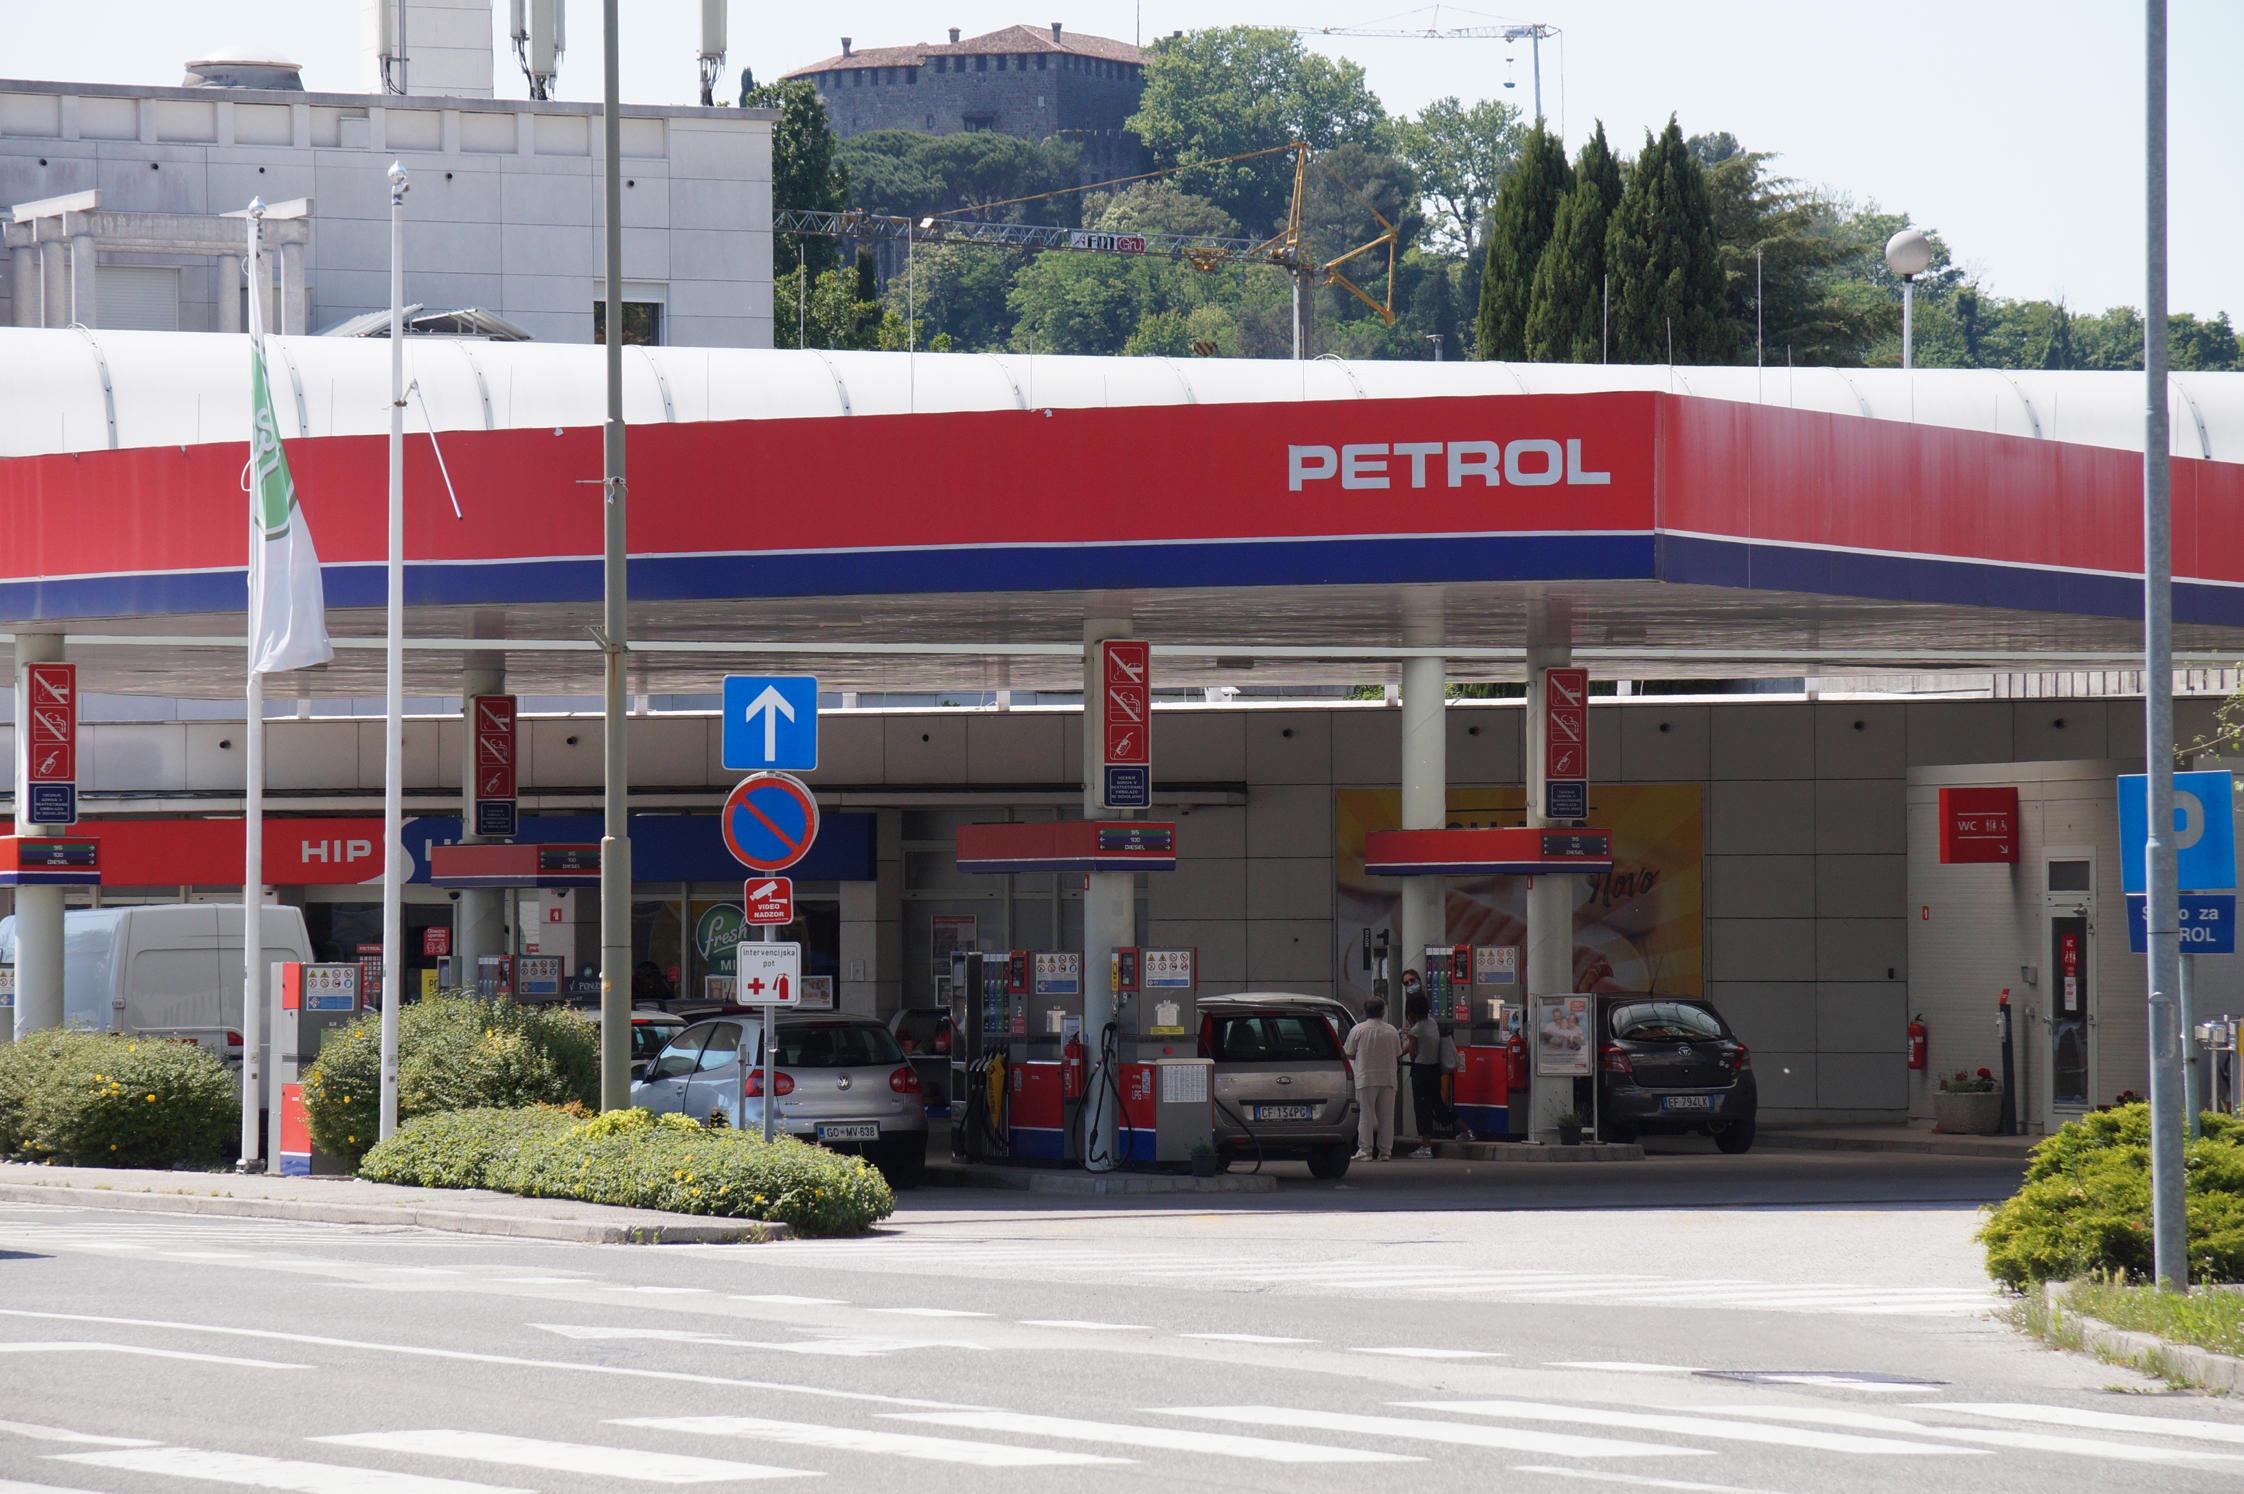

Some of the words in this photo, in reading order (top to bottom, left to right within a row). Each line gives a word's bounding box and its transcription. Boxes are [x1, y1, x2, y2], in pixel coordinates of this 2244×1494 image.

[1288, 438, 1611, 492] PETROL
[1958, 821, 1977, 831] WC
[301, 839, 372, 863] HIP
[2199, 908, 2219, 920] za
[762, 960, 775, 968] pot
[826, 1128, 840, 1138] GO
